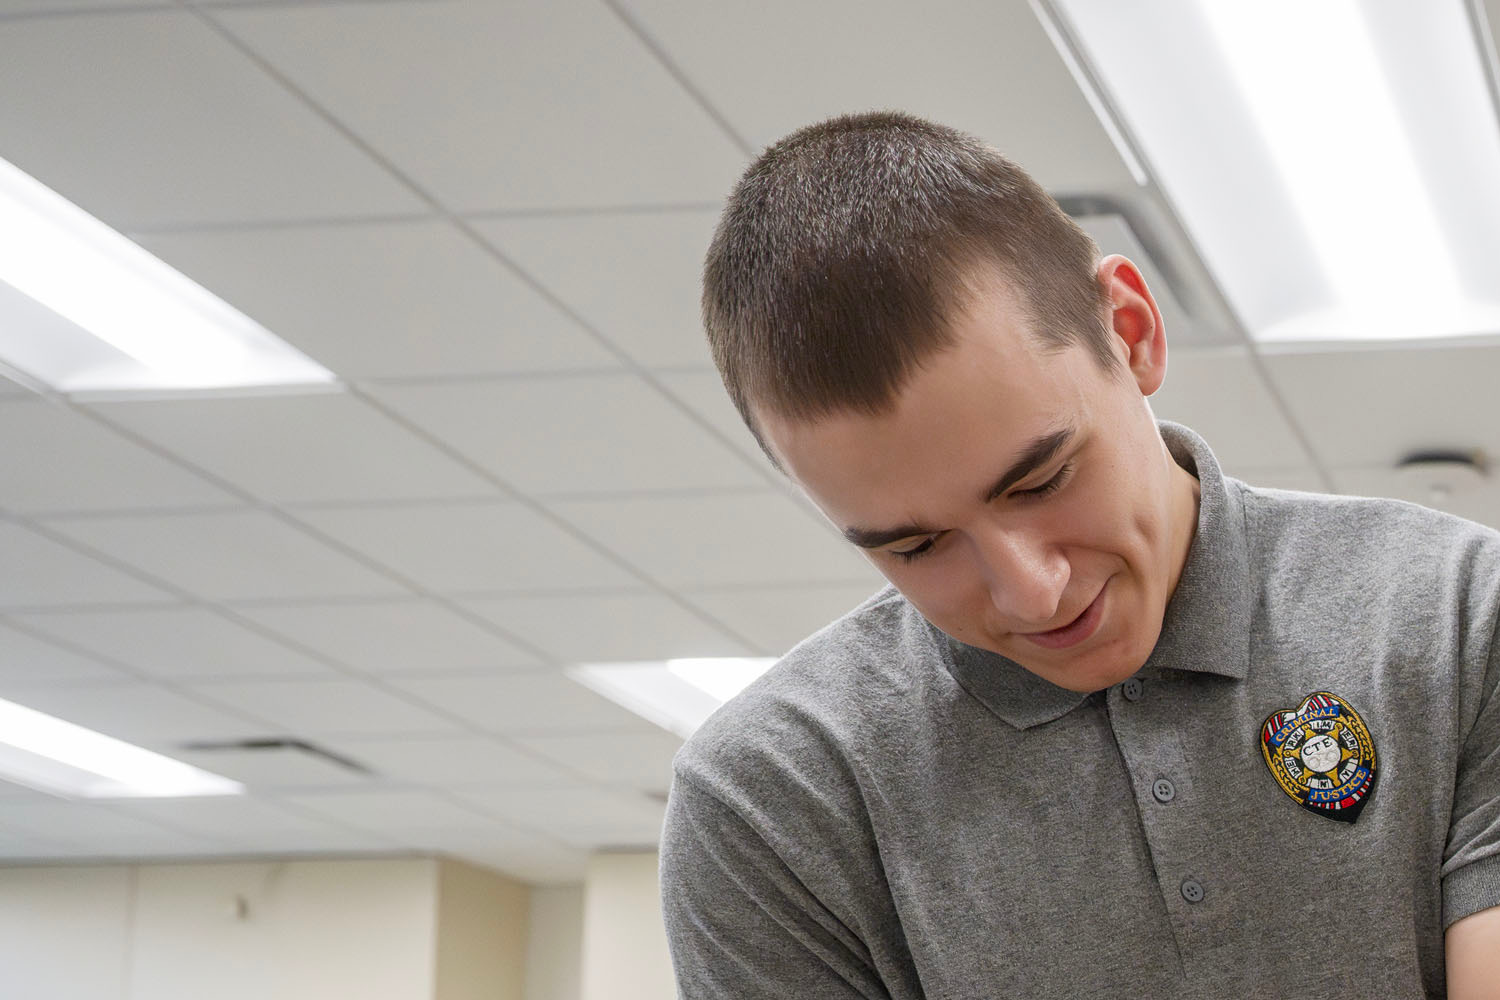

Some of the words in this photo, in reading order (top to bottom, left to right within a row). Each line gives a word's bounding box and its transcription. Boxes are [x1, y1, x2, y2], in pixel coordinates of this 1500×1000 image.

[1275, 708, 1337, 742] CRIMINAL
[1303, 737, 1333, 757] CTE
[1311, 770, 1367, 801] JUSTICE
